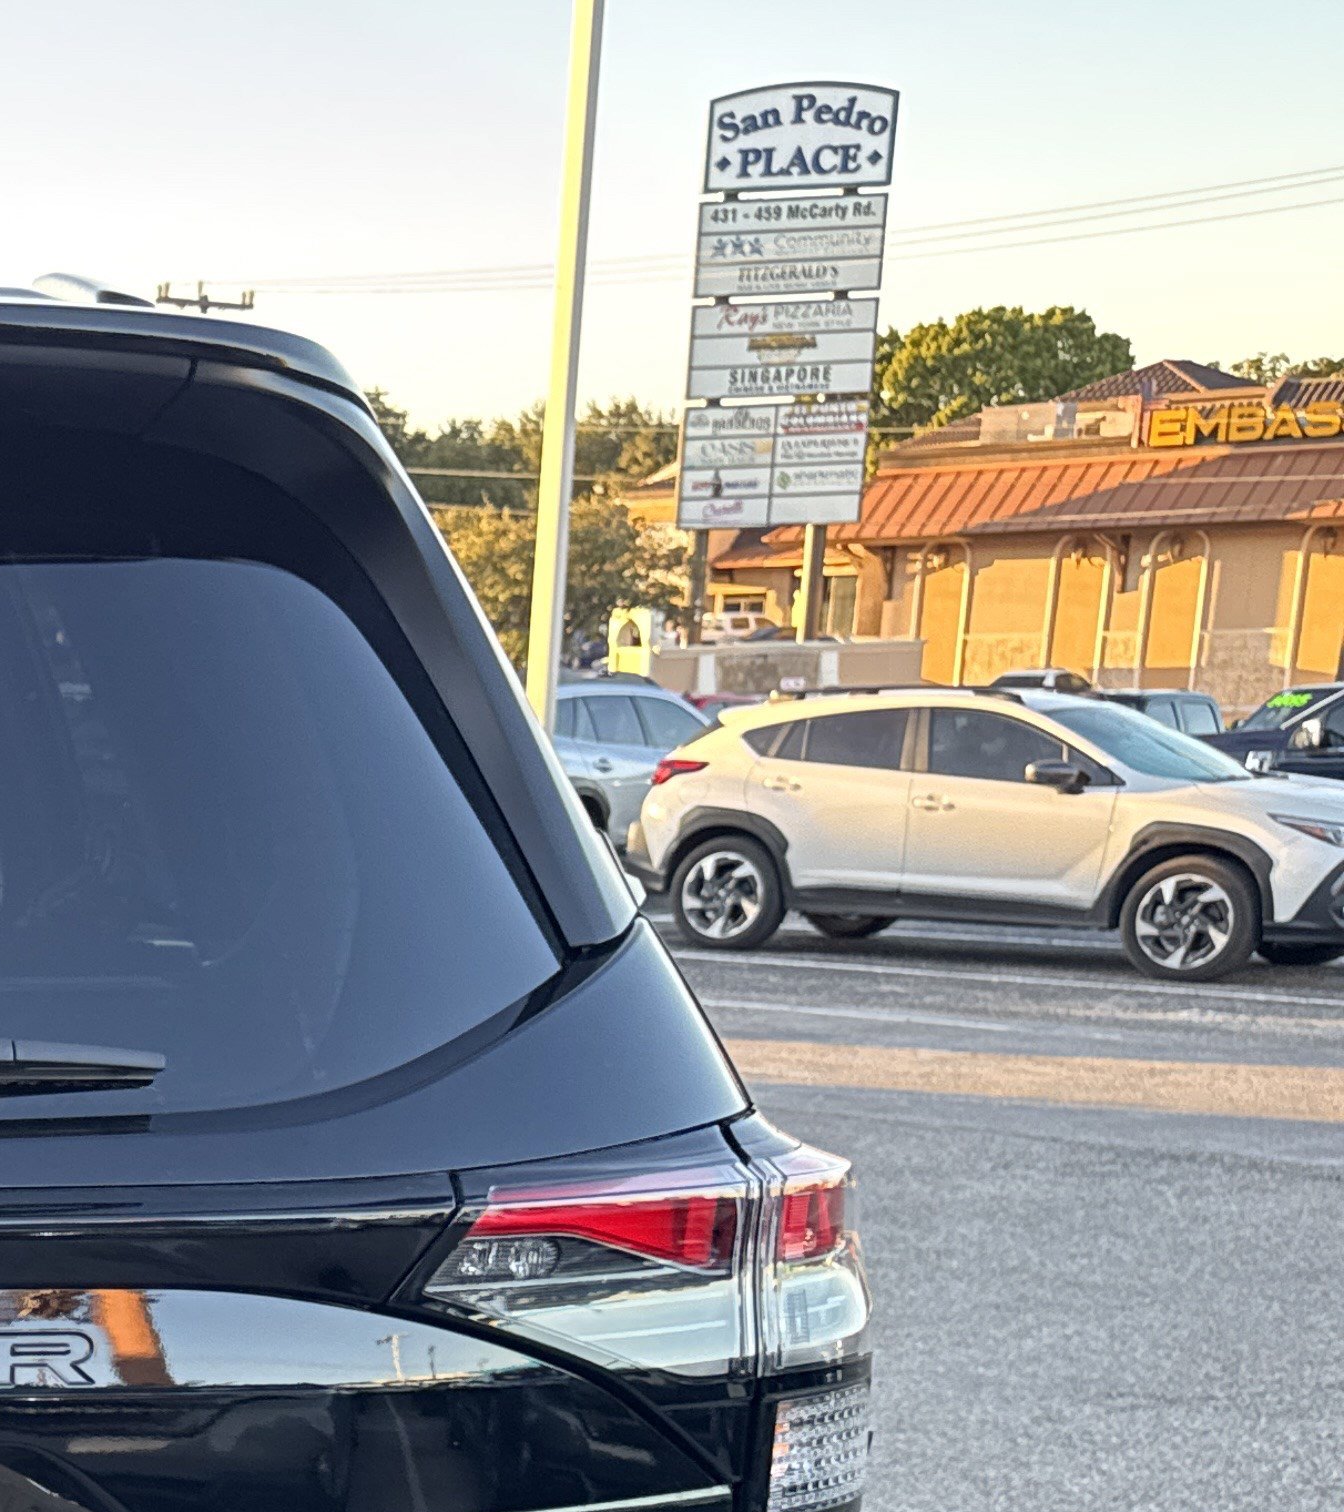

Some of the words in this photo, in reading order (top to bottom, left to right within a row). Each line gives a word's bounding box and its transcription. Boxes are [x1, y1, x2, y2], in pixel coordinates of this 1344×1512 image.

[716, 107, 783, 143] San
[790, 93, 889, 137] Pedro
[736, 144, 861, 178] PLACE
[710, 207, 738, 224] 431
[754, 205, 783, 222] 459
[786, 202, 848, 222] McCarty
[852, 201, 876, 217] Rd.
[728, 364, 833, 385] SINGAPORE
[1148, 401, 1344, 448] EMBAS
